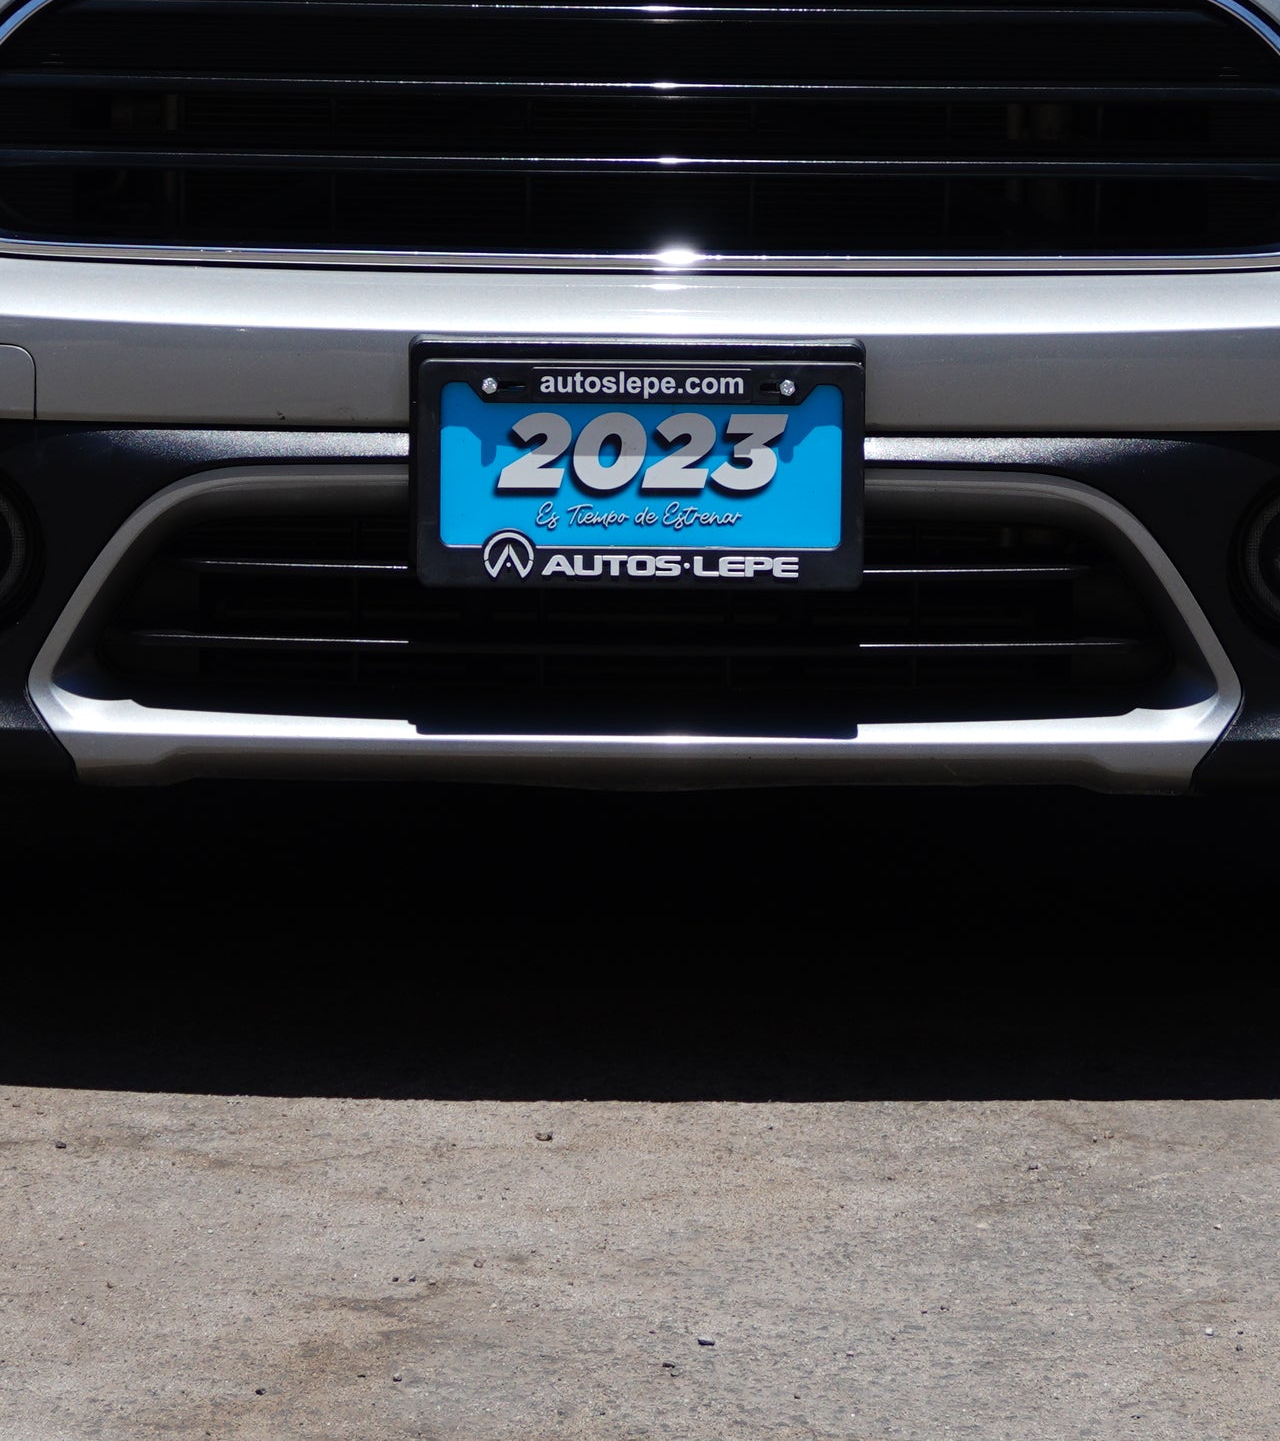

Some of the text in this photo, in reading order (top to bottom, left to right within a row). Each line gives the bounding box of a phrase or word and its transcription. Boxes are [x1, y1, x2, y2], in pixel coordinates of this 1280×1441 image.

[538, 370, 745, 400] autoslepe.com
[496, 411, 790, 492] 2023
[535, 500, 743, 529] Es Tiempo de Estrenar
